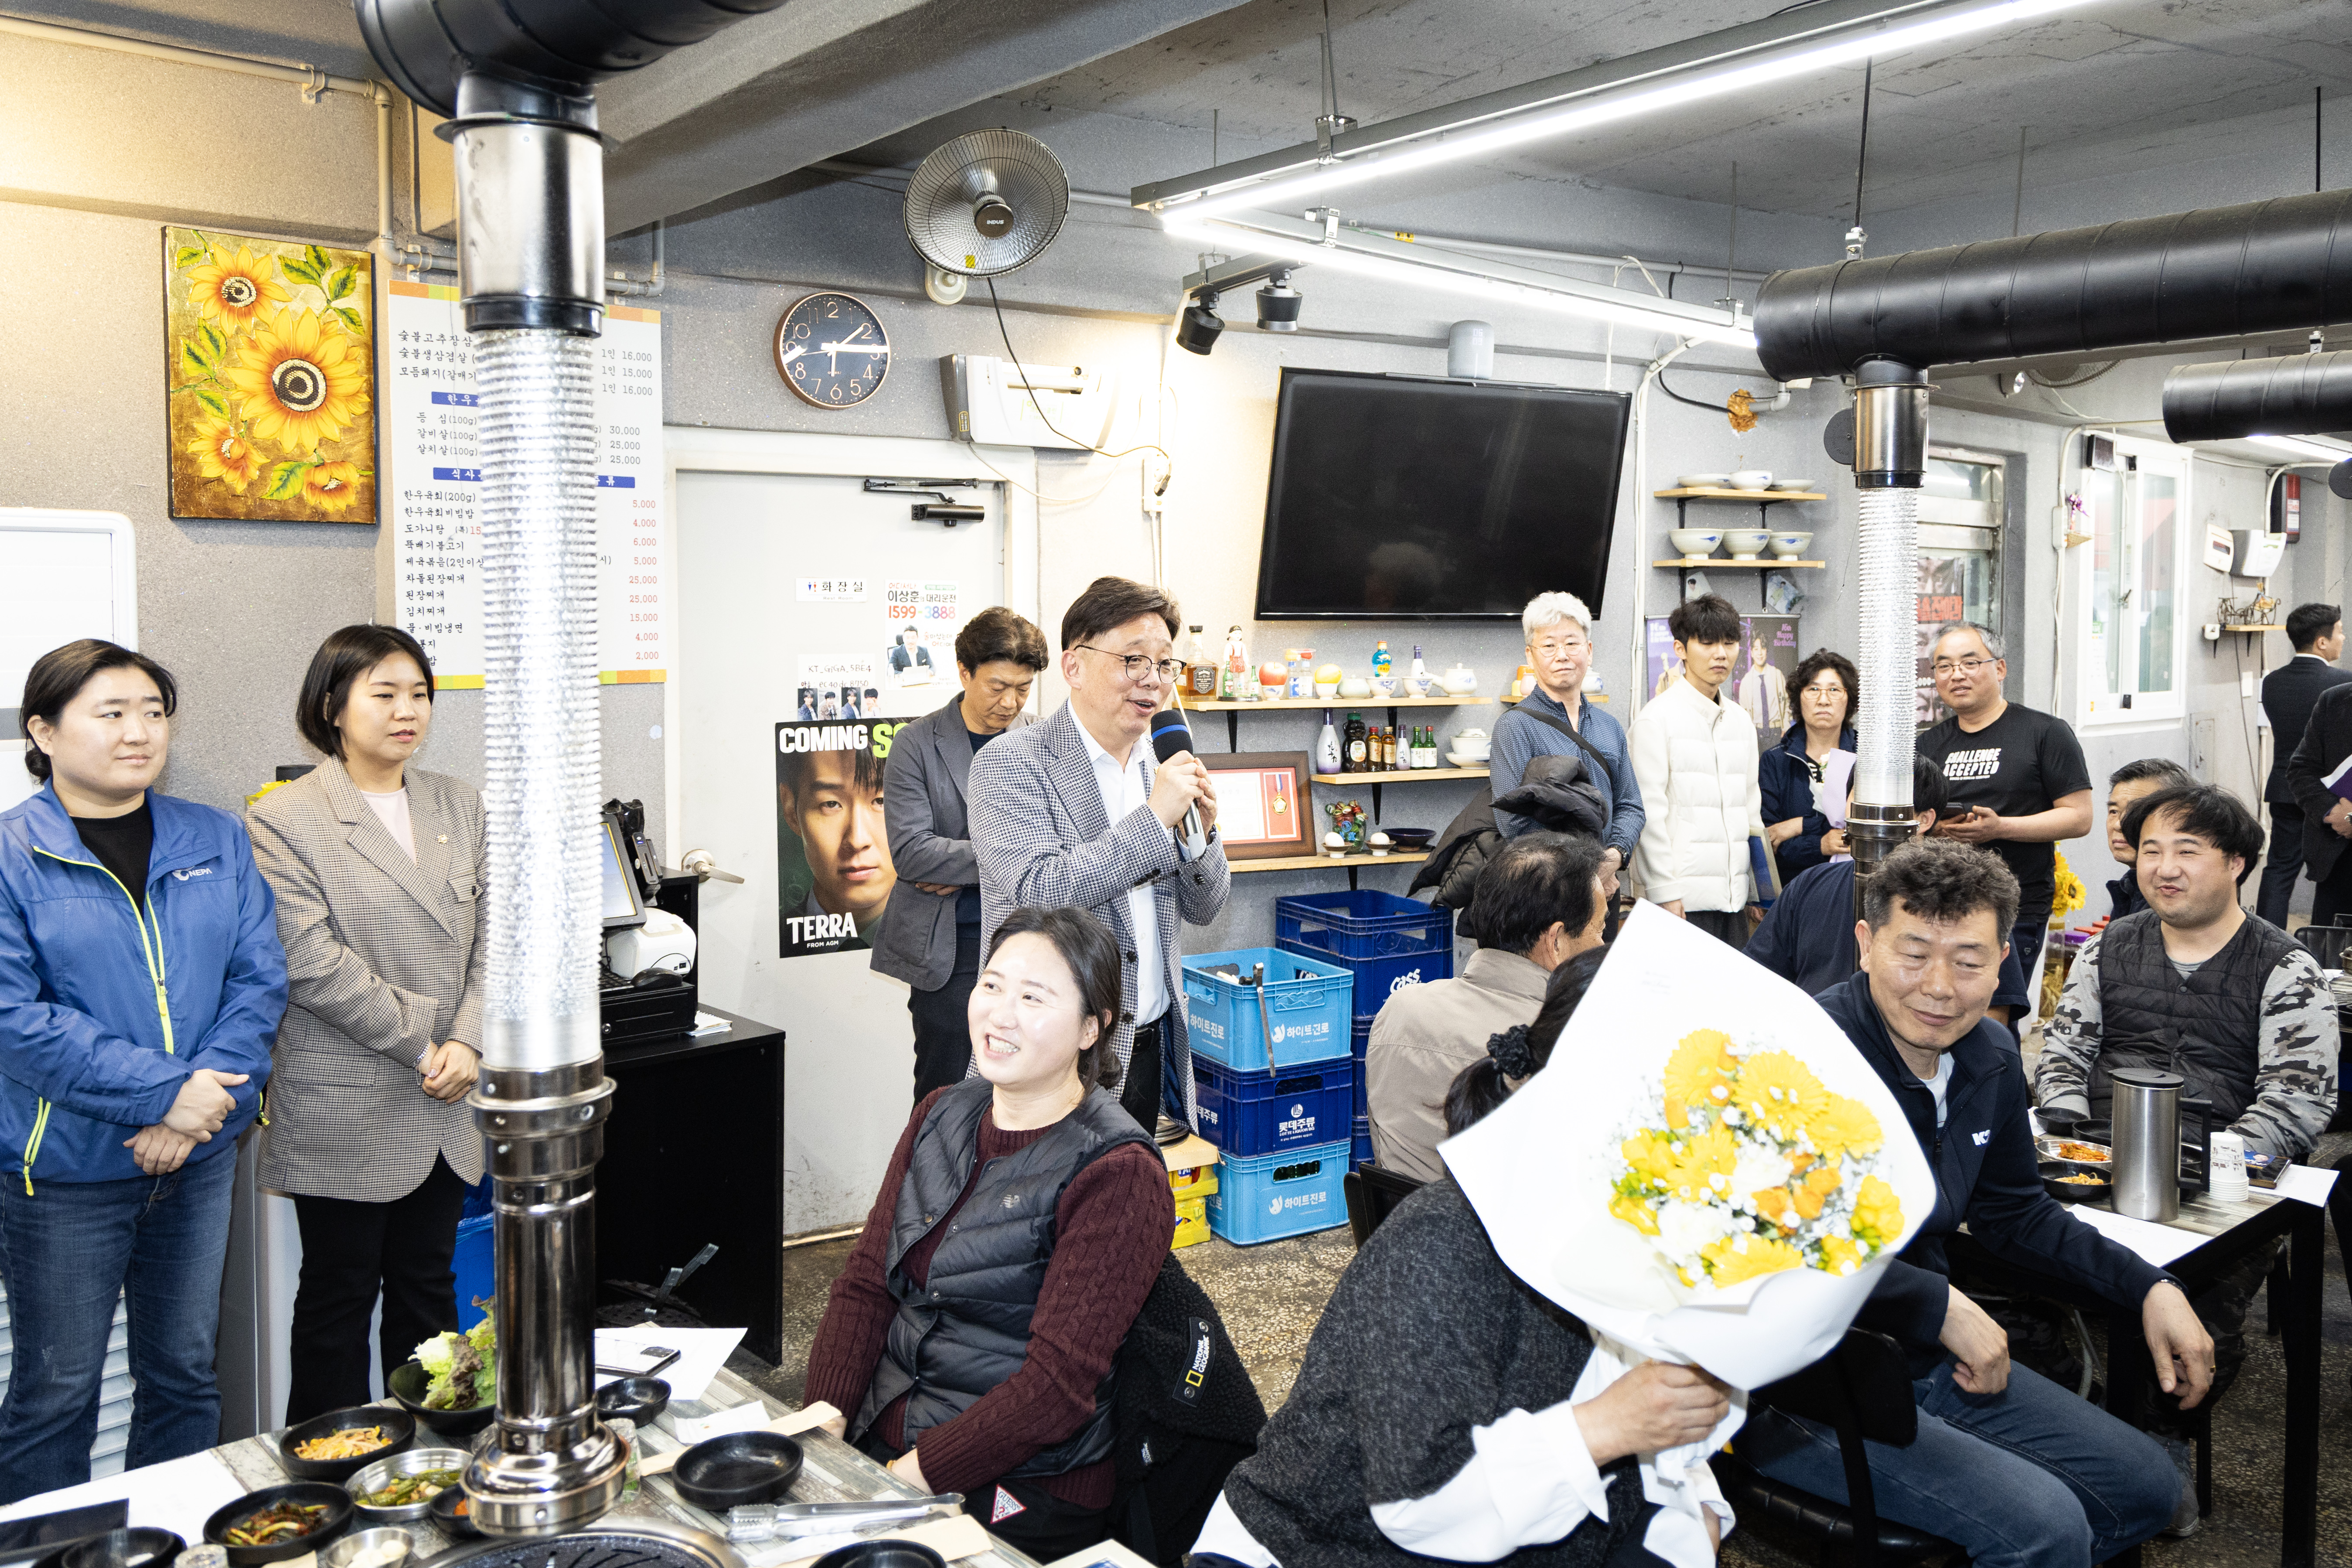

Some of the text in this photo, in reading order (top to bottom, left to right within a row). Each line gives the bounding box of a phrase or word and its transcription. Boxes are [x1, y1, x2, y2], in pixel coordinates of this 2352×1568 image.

[807, 307, 819, 324] 11
[823, 301, 839, 318] 12
[849, 307, 853, 324] 1
[792, 322, 811, 339] 10
[861, 323, 872, 339] 2
[399, 347, 467, 364] 숯불생삼겹살
[602, 349, 652, 361] 1인 16,000
[602, 366, 652, 378] 1인 15,000
[795, 362, 806, 379] 8
[862, 364, 873, 380] 4
[603, 383, 652, 395] 1인 16,000
[811, 378, 822, 394] 7
[830, 383, 842, 400] 6
[850, 379, 861, 395] 5
[417, 428, 477, 441] 갈비살(100g)
[610, 426, 640, 435] 30,000
[417, 443, 477, 457] 살치살(100g)
[610, 440, 640, 450] 25,000
[610, 455, 641, 464] 25,000
[451, 468, 481, 480] 식사
[404, 490, 475, 503] 한우육회(200g)
[633, 500, 656, 508] 5,000
[404, 507, 474, 519] 한우육회비빔밥
[405, 524, 444, 535] 도가니탕
[633, 519, 656, 527] 4,000
[405, 540, 464, 551] 뚝배기불고기
[634, 538, 656, 546] 6,000
[596, 556, 611, 565] 시)
[634, 557, 657, 565] 5,000
[406, 573, 464, 584] 차돌된장찌개
[629, 576, 657, 584] 25,000
[821, 581, 862, 592] 화장실
[406, 590, 444, 600] 된장찌개
[630, 595, 658, 603] 25,000
[926, 594, 956, 603] 대리운전
[406, 606, 444, 617] 김치찌개
[630, 614, 658, 622] 15,000
[889, 605, 955, 619] 1599-3888
[635, 633, 658, 641] 4,000
[636, 651, 659, 660] 2,000
[779, 724, 868, 753] COMING
[1945, 748, 2001, 764] CHALLENGE
[1943, 761, 2000, 777] ACCEPTED
[188, 868, 212, 877] NEPA
[786, 912, 858, 944] TERRA
[1190, 1013, 1224, 1040] 하이트진로
[1287, 1023, 1329, 1038] 하이트진로
[1279, 1117, 1315, 1132] 롯데주류
[1206, 1194, 1222, 1210] 진로
[1284, 1191, 1327, 1210] 하이트진로
[1192, 1340, 1204, 1370] NATIONAL
[1198, 1334, 1210, 1373] GEOGRAPHIC
[998, 1491, 1019, 1510] GUESS
